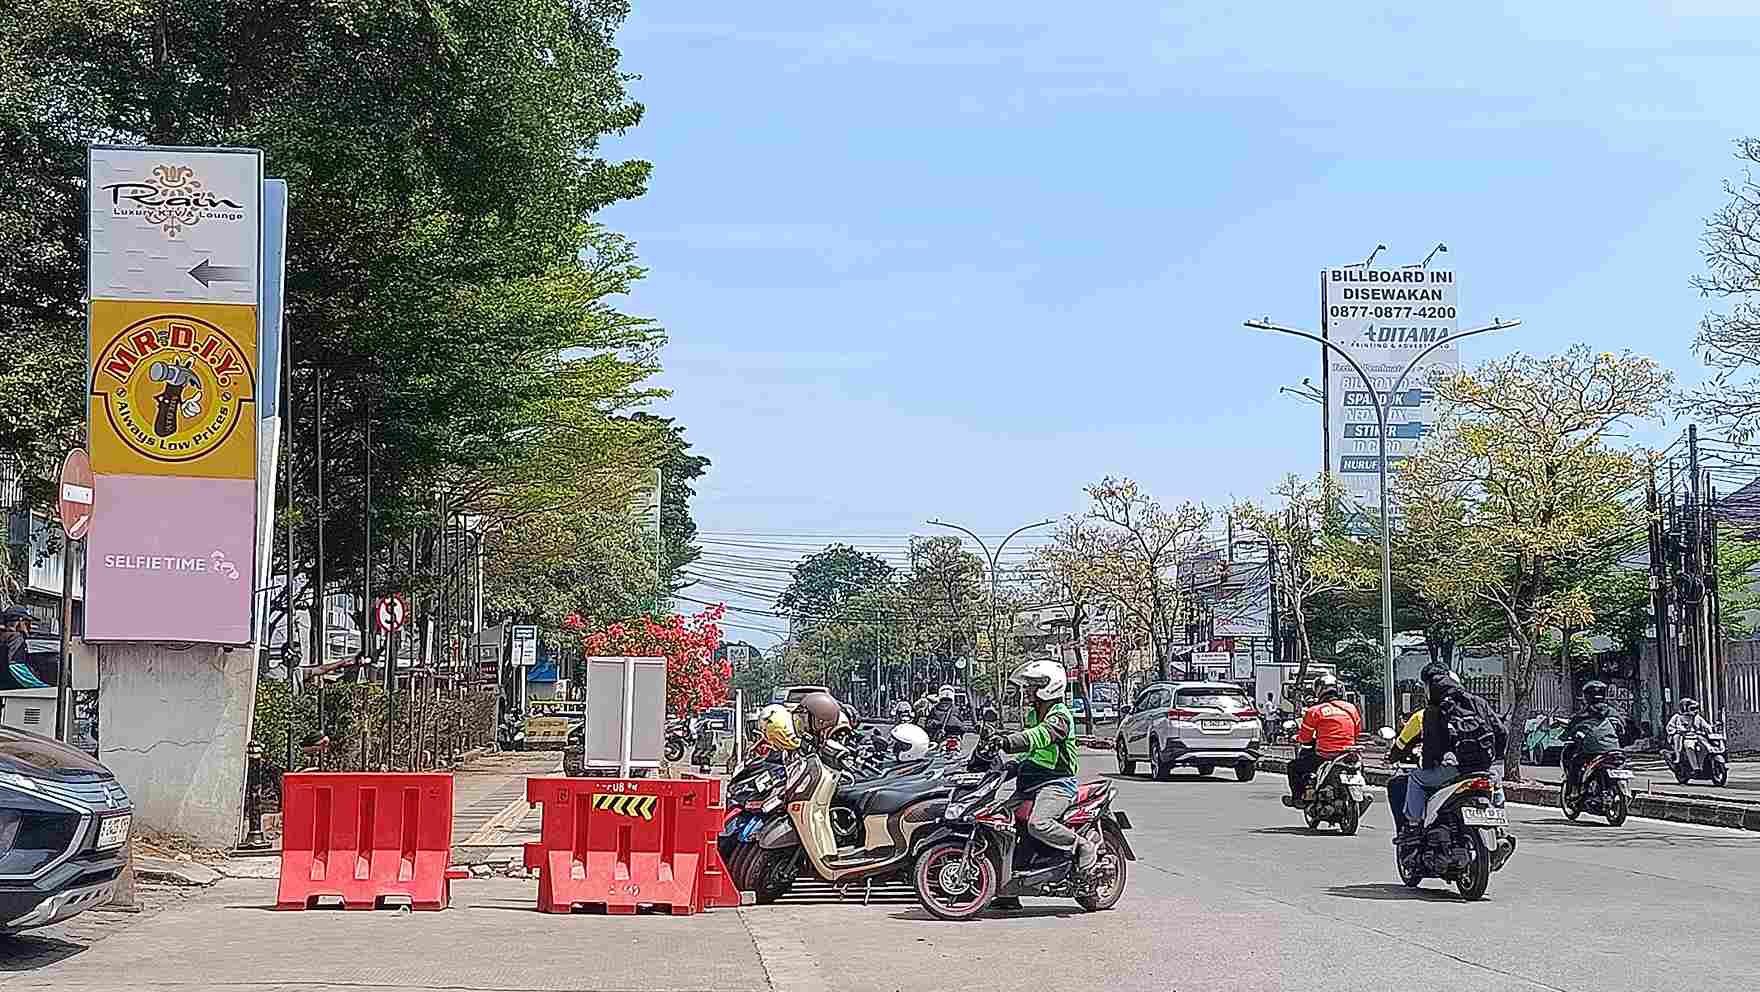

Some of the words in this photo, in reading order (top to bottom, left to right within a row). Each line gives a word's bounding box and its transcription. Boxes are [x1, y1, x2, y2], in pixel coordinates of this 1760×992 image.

[102, 184, 243, 208] Rain
[113, 207, 154, 217] Luxury
[199, 211, 243, 221] Lounge
[1331, 270, 1425, 282] BILLBOARD
[1430, 271, 1453, 283] INI
[1343, 288, 1442, 301] DISEWAKAN
[1330, 306, 1456, 319] 0877-0877-4200
[1346, 393, 1404, 405] SPADK
[117, 400, 156, 447] Always
[159, 439, 191, 450] Low
[192, 406, 229, 446] Prices
[1368, 440, 1401, 453] CRD
